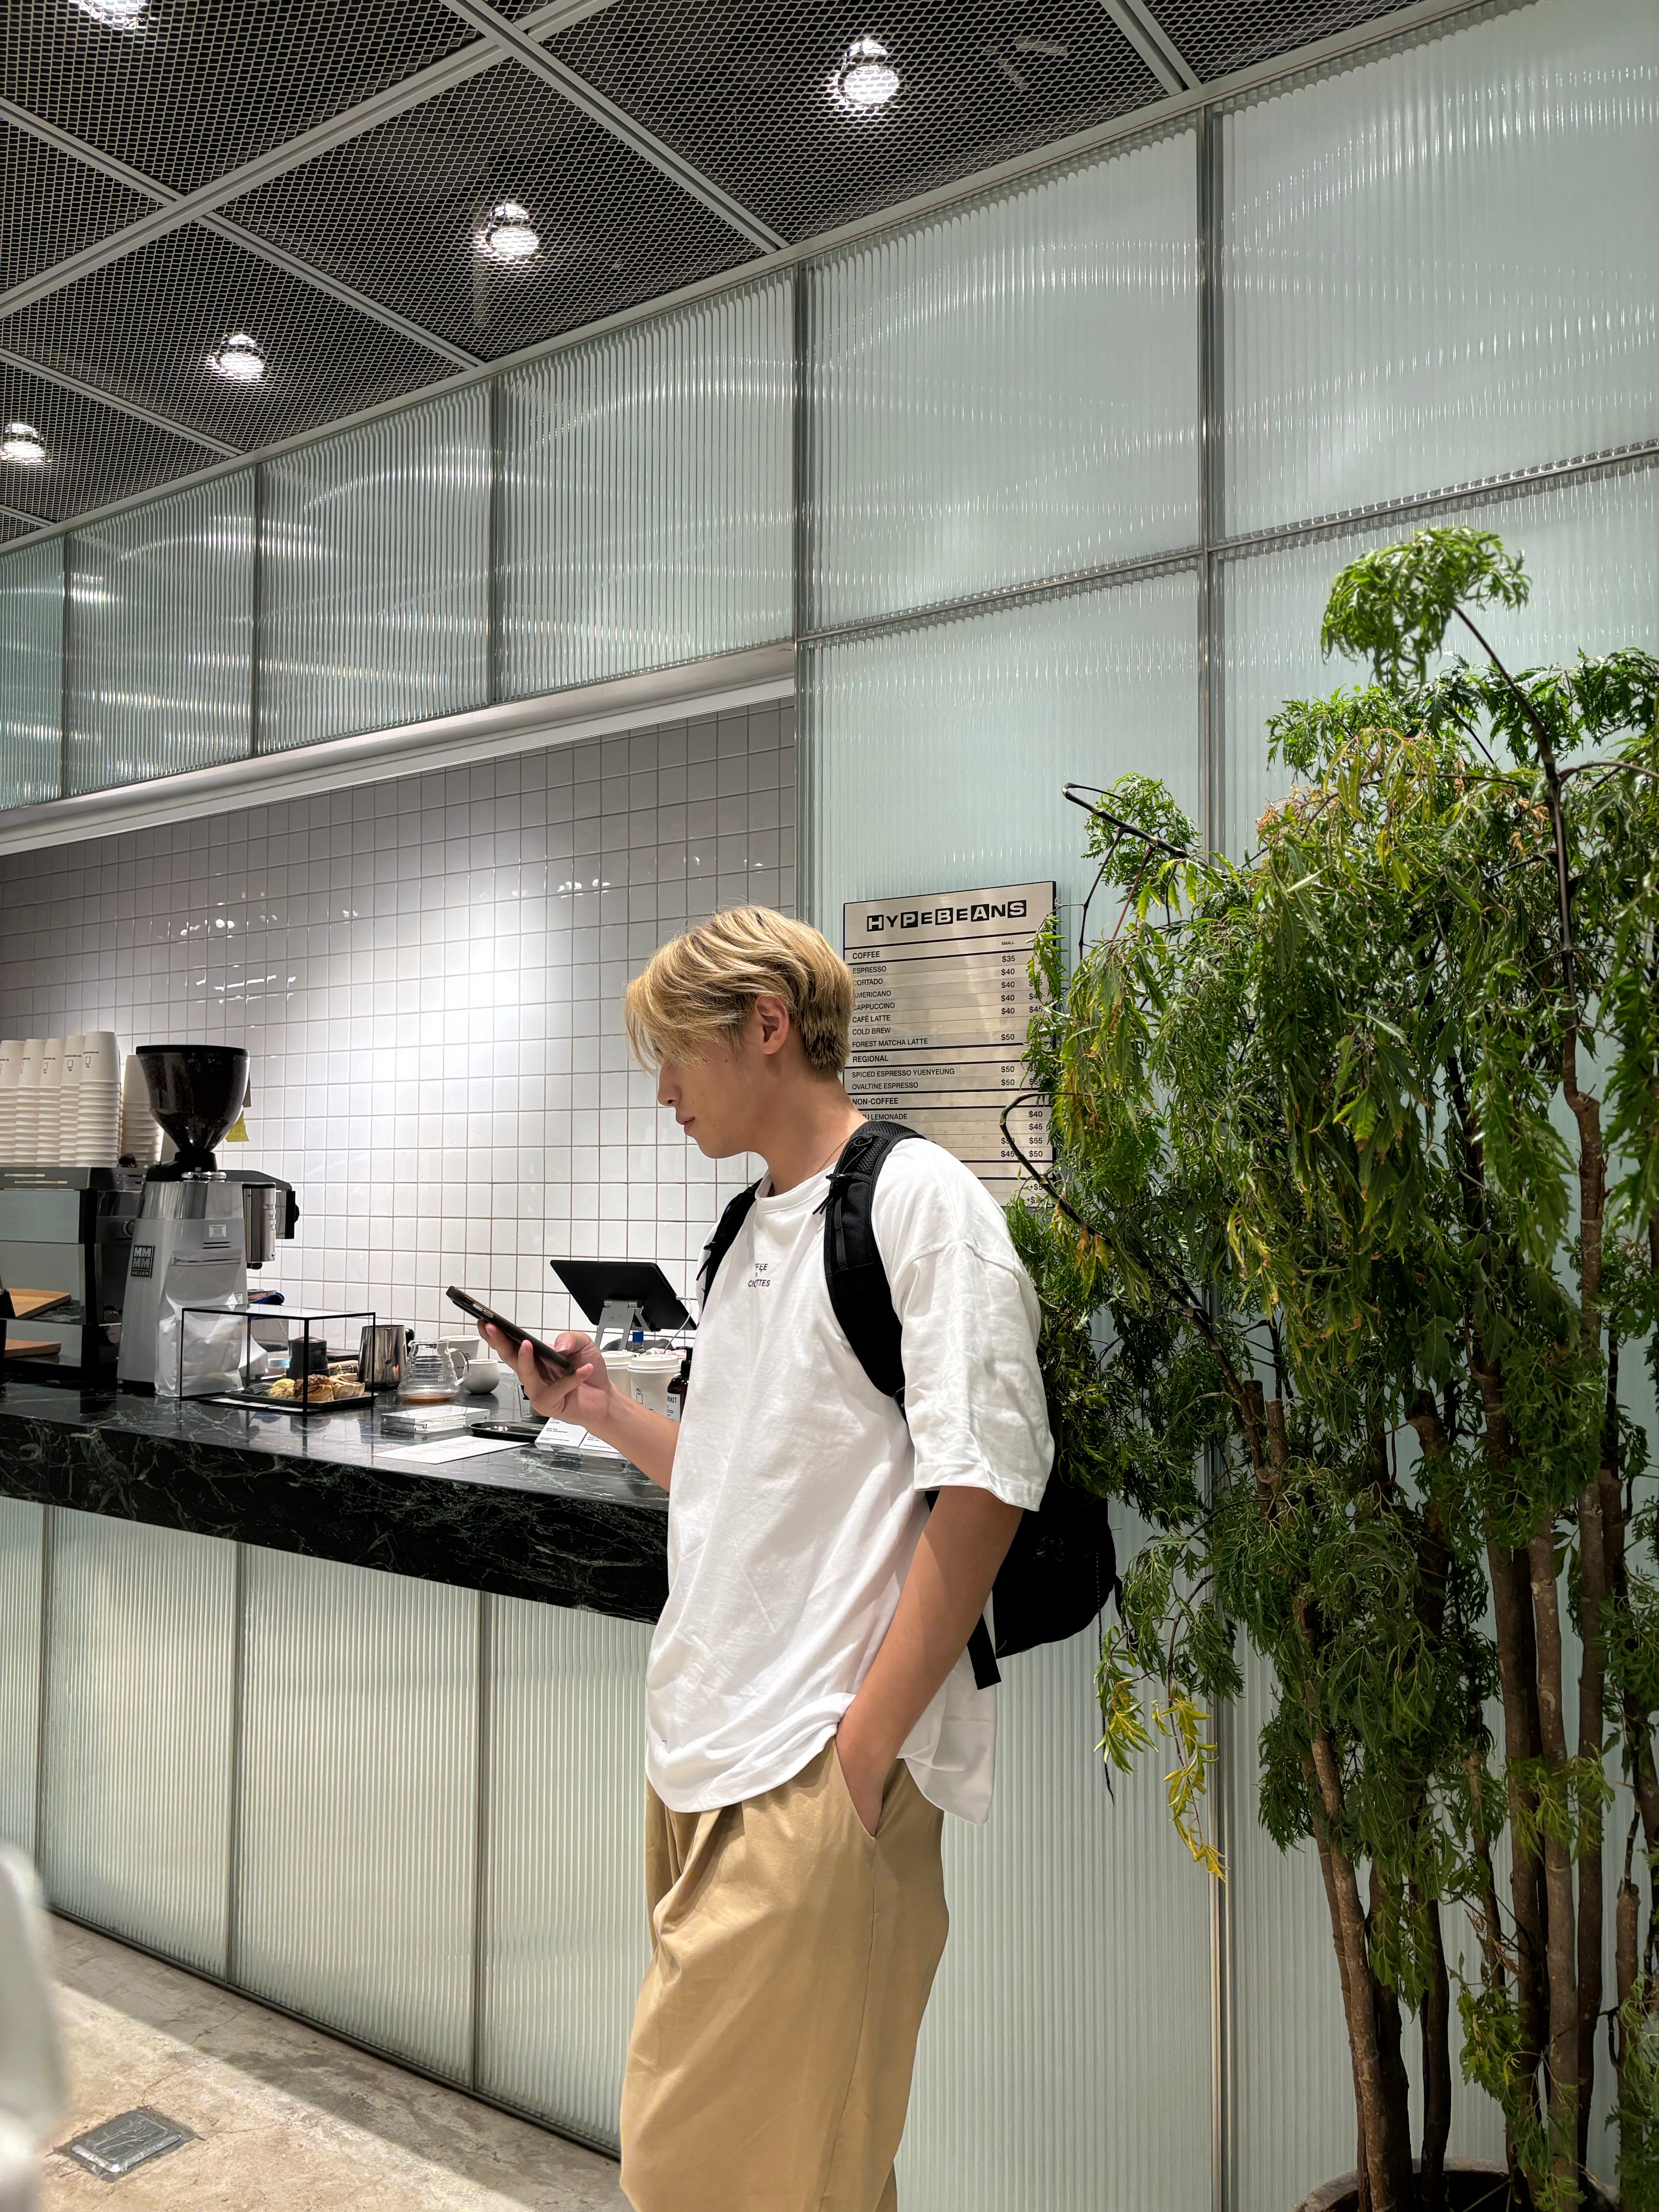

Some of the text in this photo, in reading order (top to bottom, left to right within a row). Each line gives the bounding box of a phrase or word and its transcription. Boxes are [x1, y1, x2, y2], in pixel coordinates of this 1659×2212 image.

[867, 899, 1027, 932] HYPEBEANS
[853, 951, 880, 959] COFFEE
[852, 1014, 869, 1023] CAFÉ
